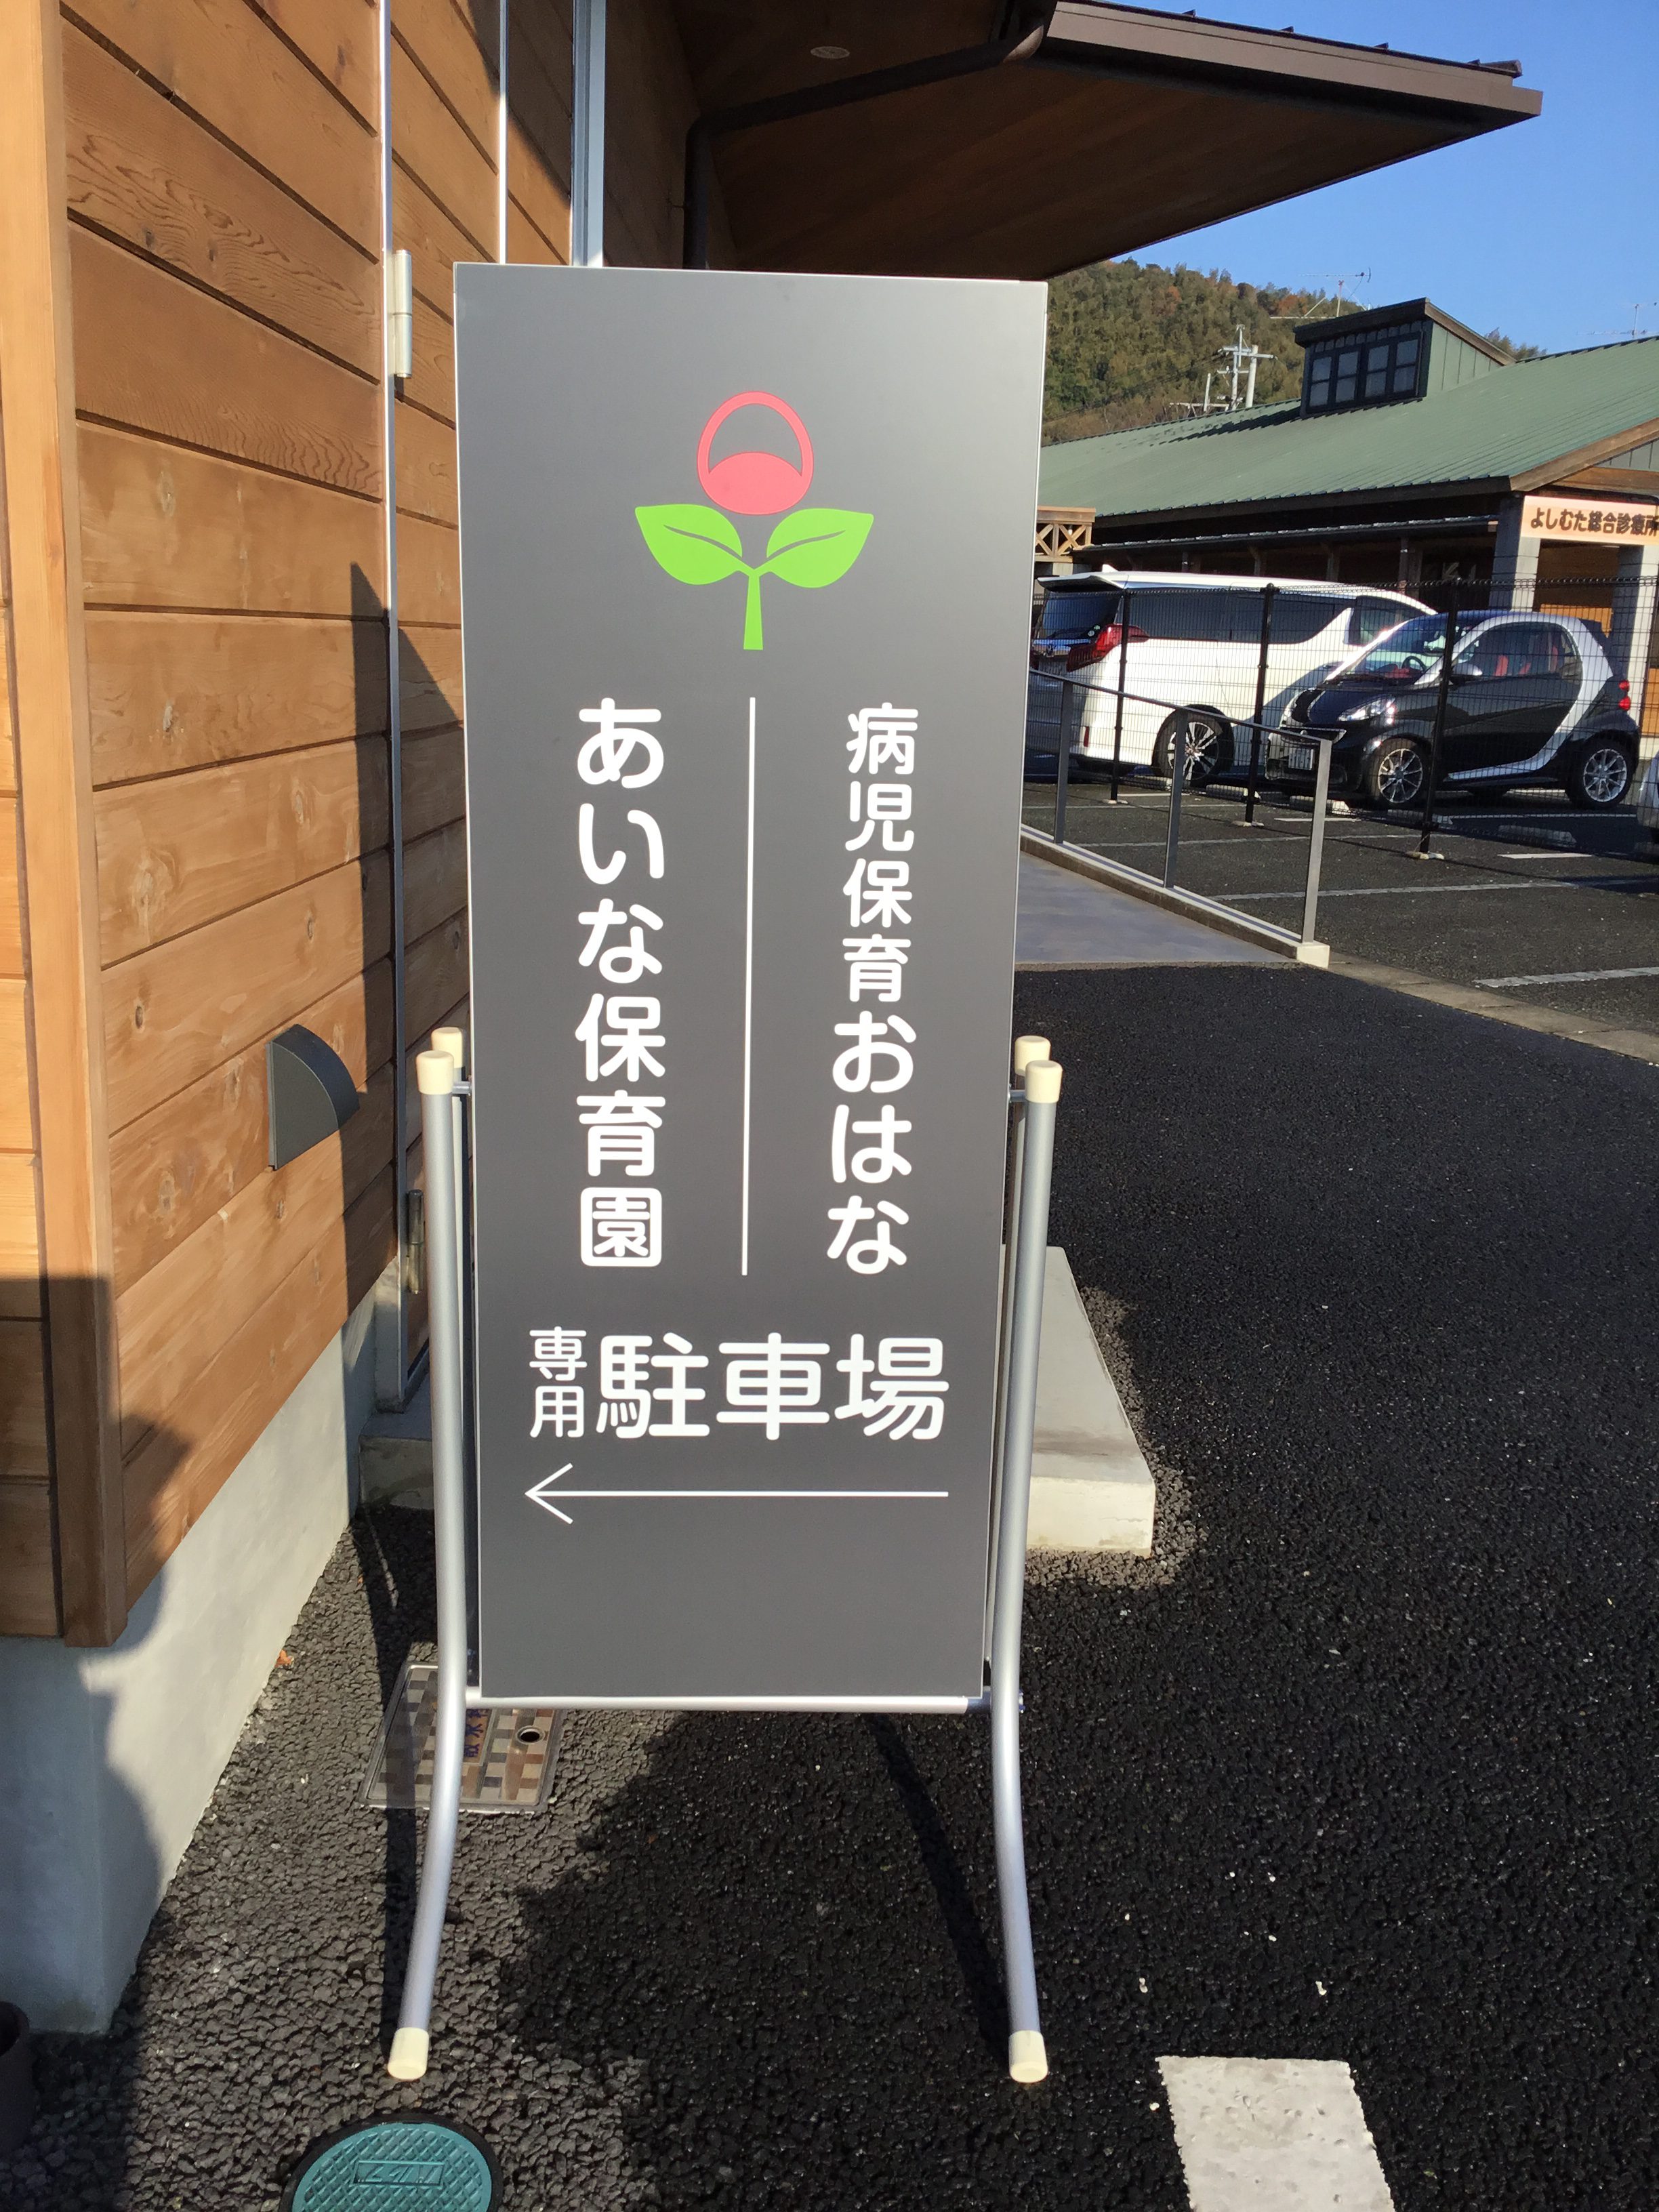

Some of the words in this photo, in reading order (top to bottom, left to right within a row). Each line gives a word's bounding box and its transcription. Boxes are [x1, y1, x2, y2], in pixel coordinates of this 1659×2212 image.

[1530, 507, 1659, 537] よしむた総合診療所
[575, 697, 665, 1267] あいな保育園
[827, 702, 919, 1275] 病児保育おはな
[529, 1326, 587, 1438] 専用
[596, 1332, 949, 1440] 駐車場
